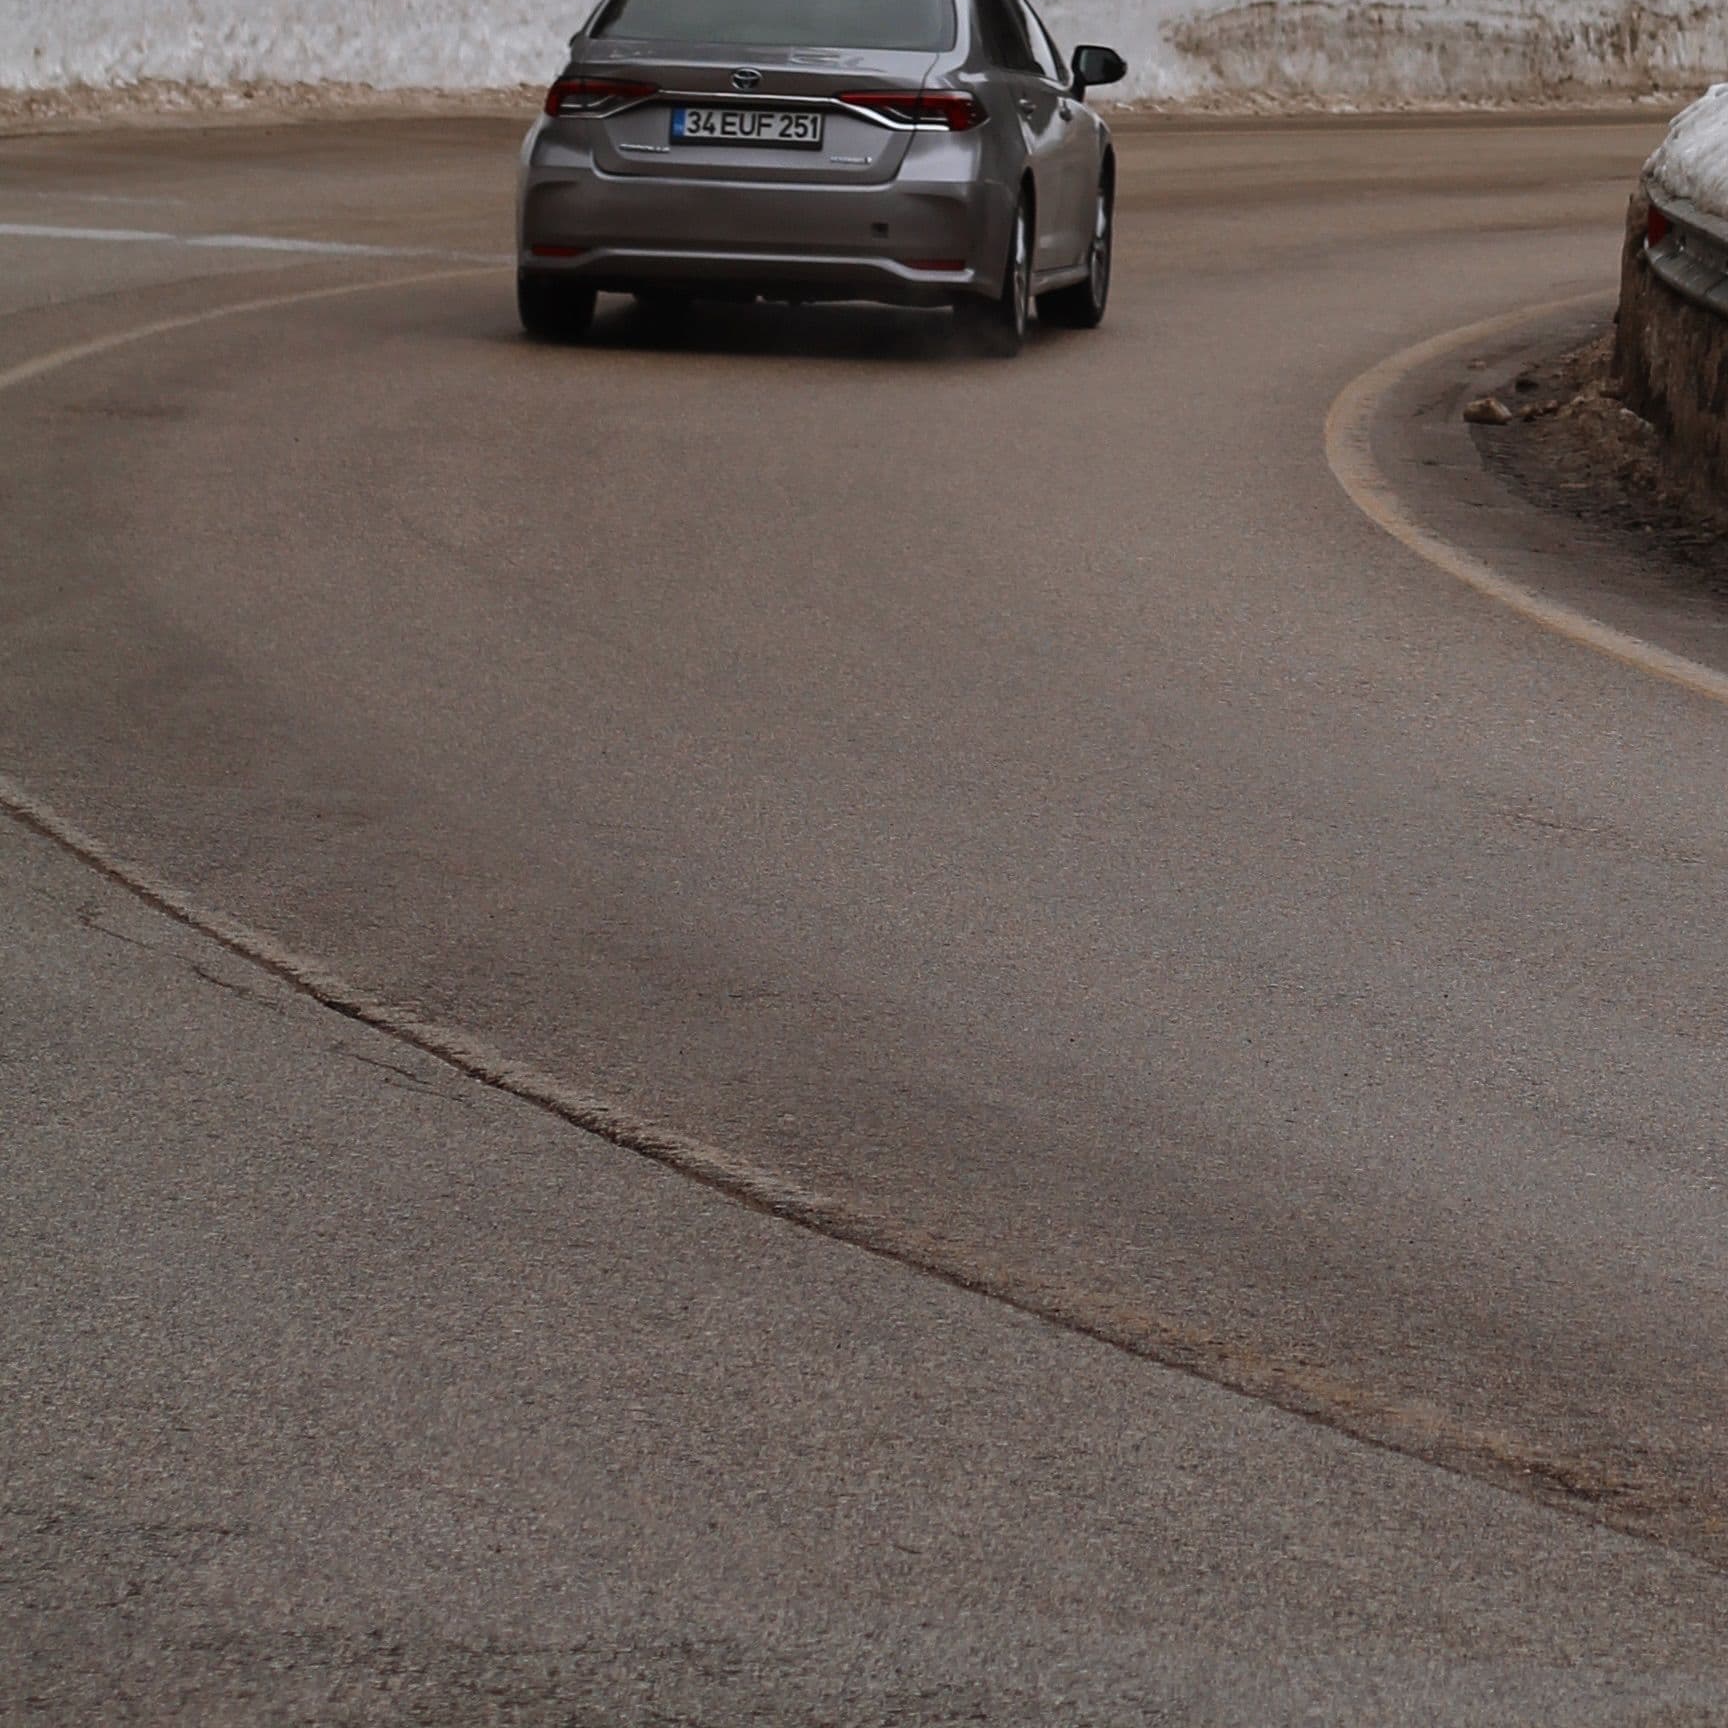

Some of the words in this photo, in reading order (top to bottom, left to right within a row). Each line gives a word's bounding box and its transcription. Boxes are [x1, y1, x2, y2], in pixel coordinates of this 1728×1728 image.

[687, 111, 716, 135] 34
[720, 112, 775, 136] EUF
[779, 115, 819, 139] 251
